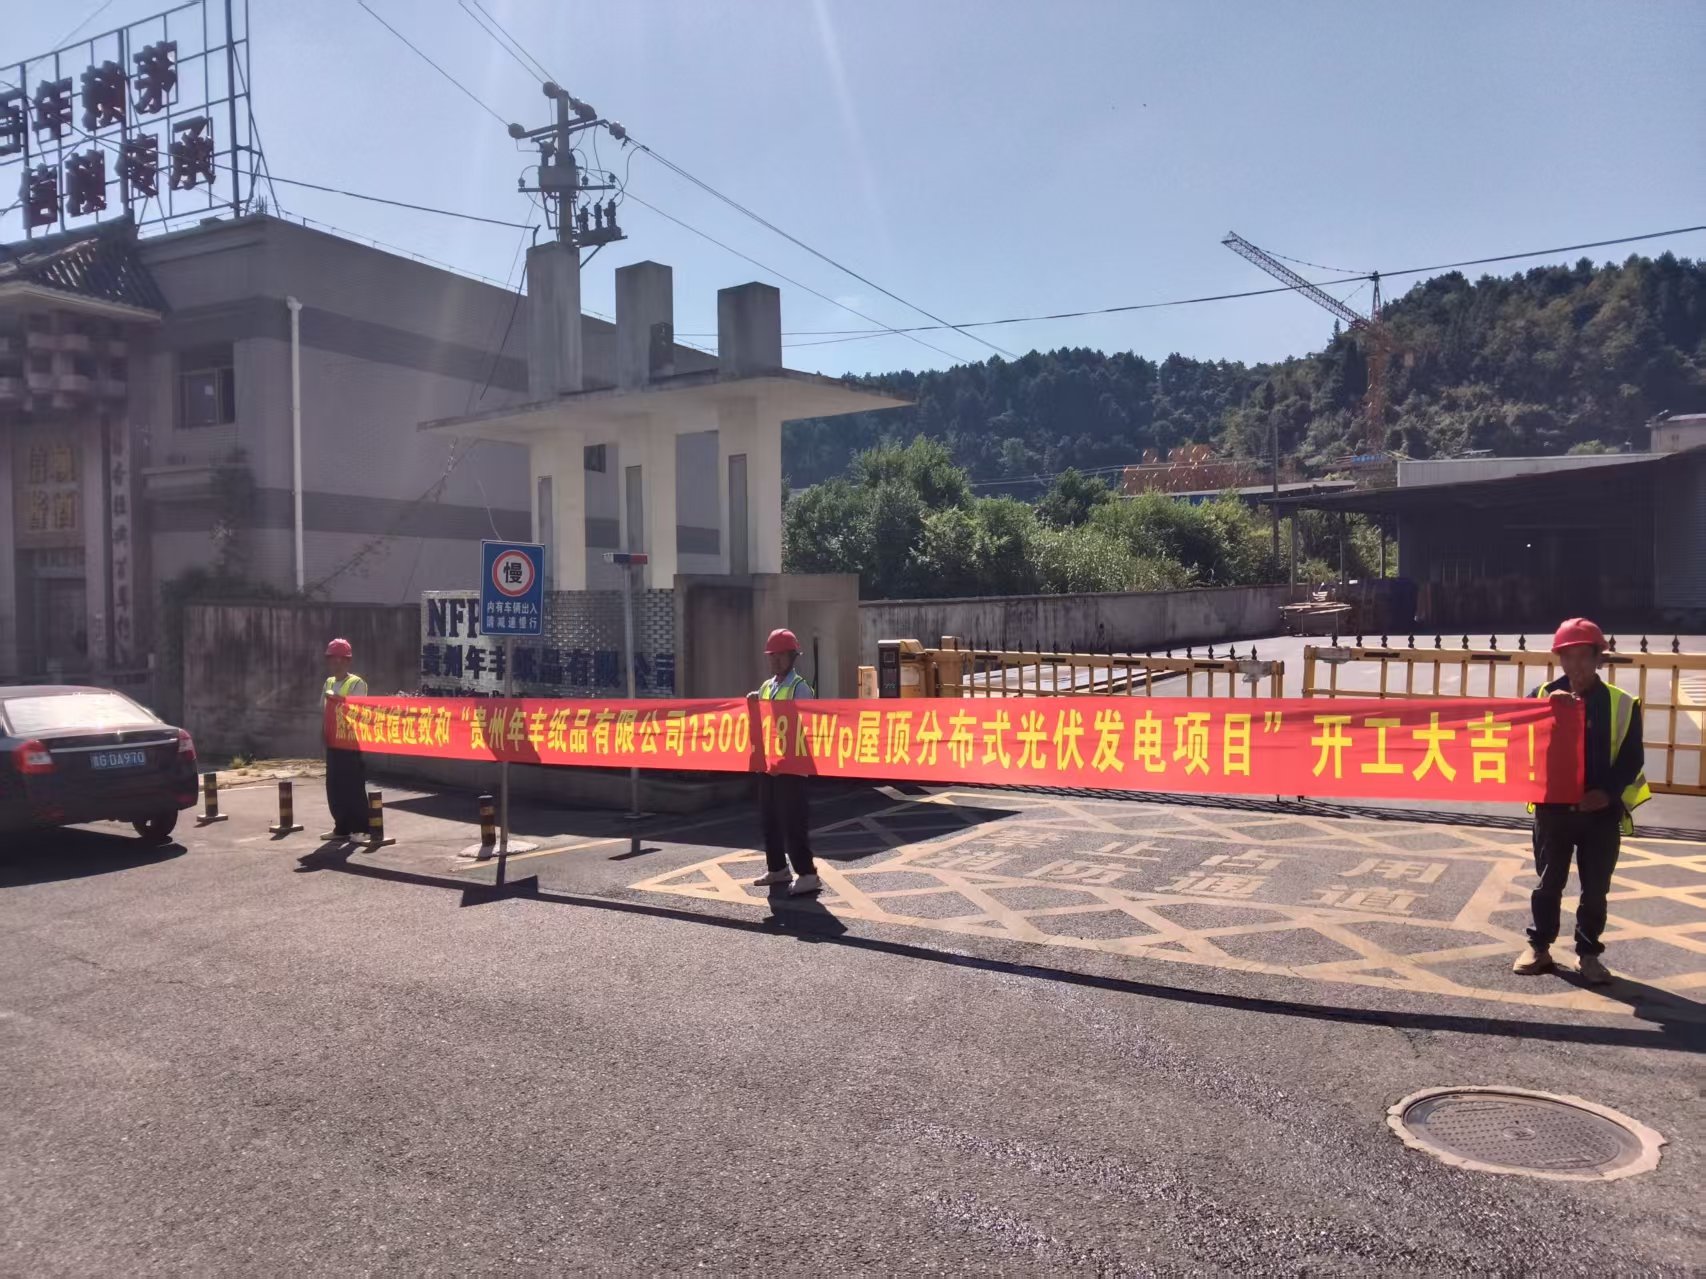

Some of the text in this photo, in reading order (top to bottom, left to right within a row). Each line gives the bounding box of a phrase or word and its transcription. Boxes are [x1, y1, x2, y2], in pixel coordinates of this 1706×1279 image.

[503, 561, 523, 584] 慢
[486, 600, 538, 615] 内有车辆出入
[966, 826, 1449, 885] 禁止占用
[926, 848, 1430, 912] 消防通道
